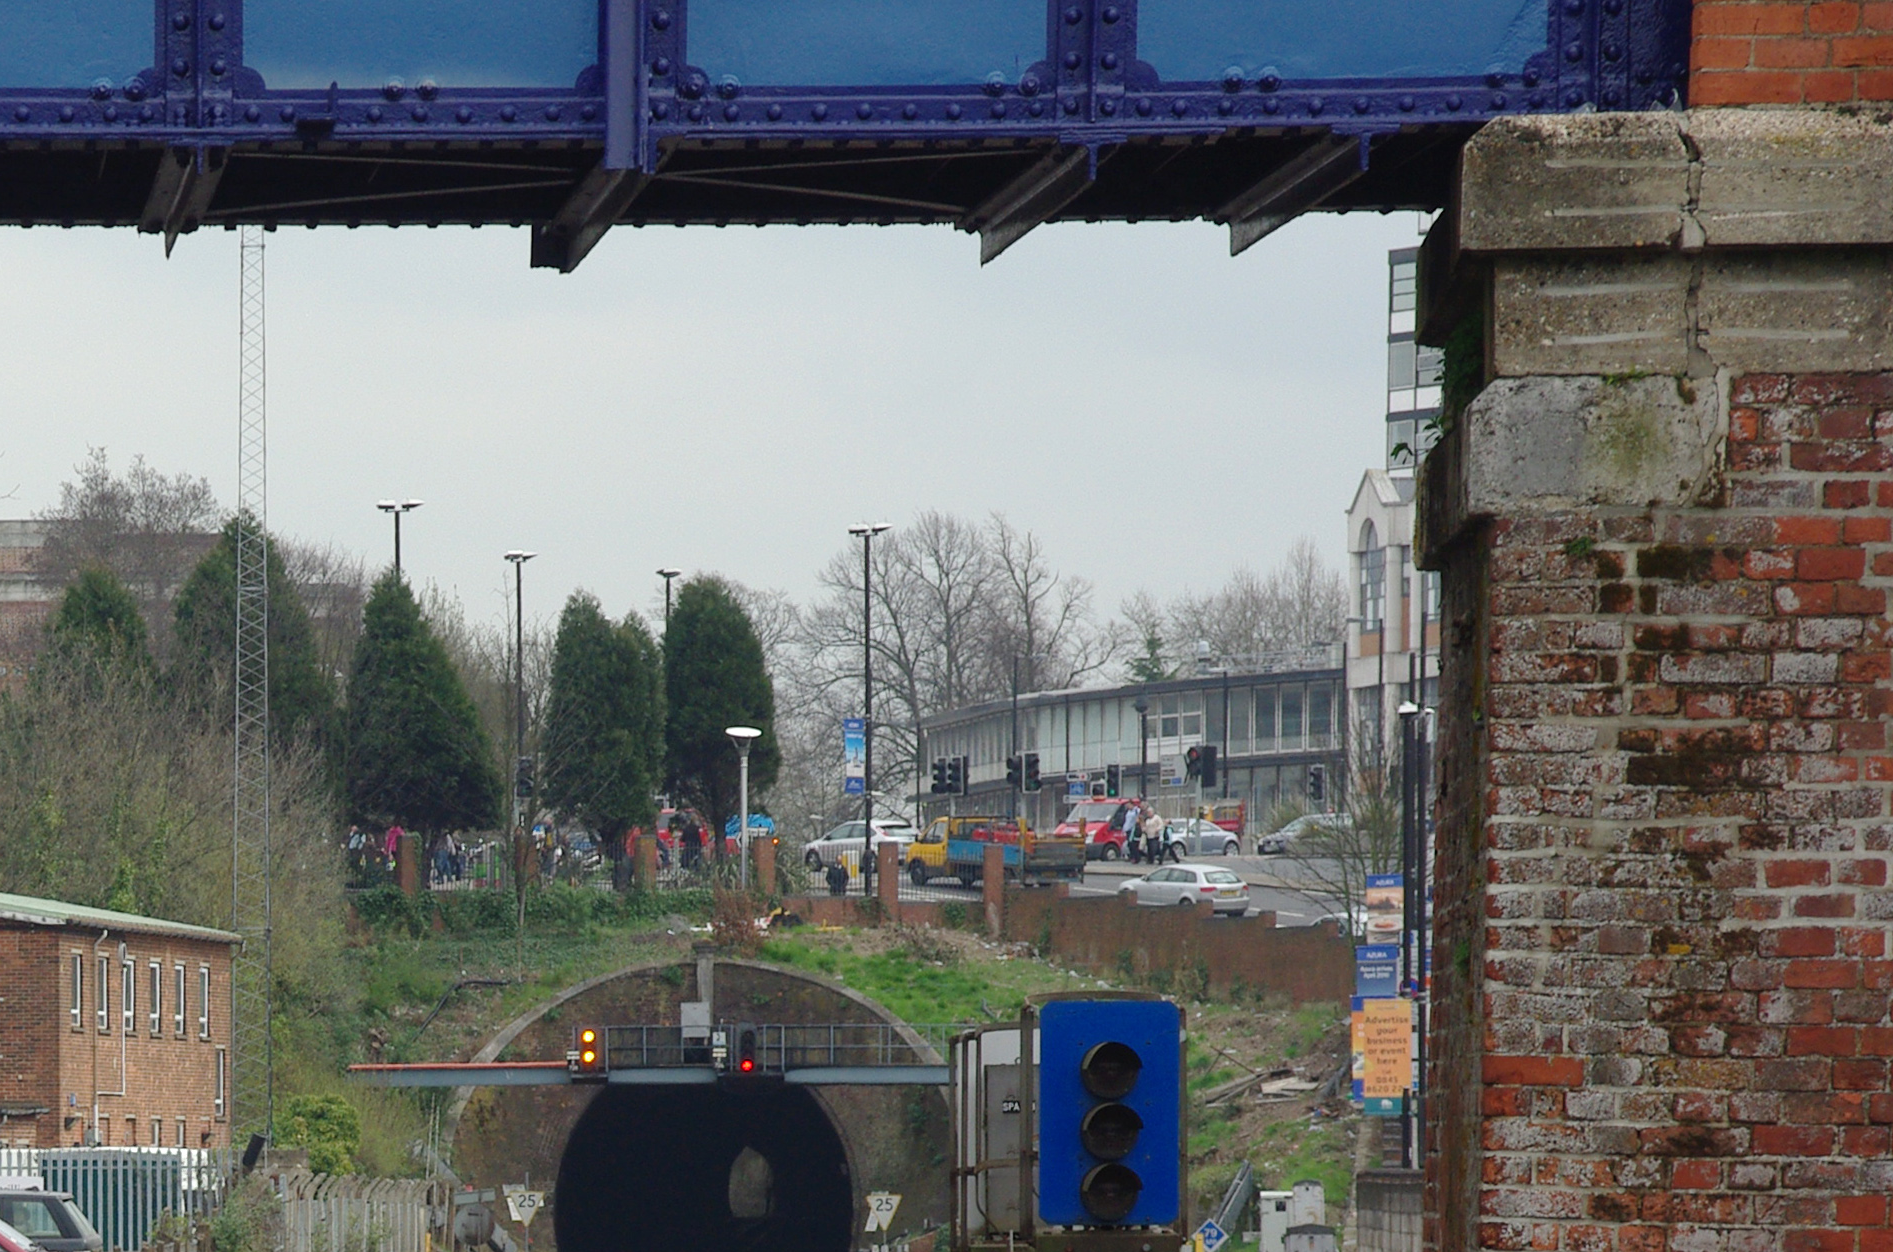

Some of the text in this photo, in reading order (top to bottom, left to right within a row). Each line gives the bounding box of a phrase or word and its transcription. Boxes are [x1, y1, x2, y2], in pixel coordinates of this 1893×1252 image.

[1365, 1016, 1408, 1024] Advertise
[1376, 1028, 1397, 1036] your
[1367, 1037, 1408, 1045] business
[1002, 1101, 1021, 1112] SPA
[518, 1194, 536, 1208] 25
[876, 1197, 893, 1212] 25
